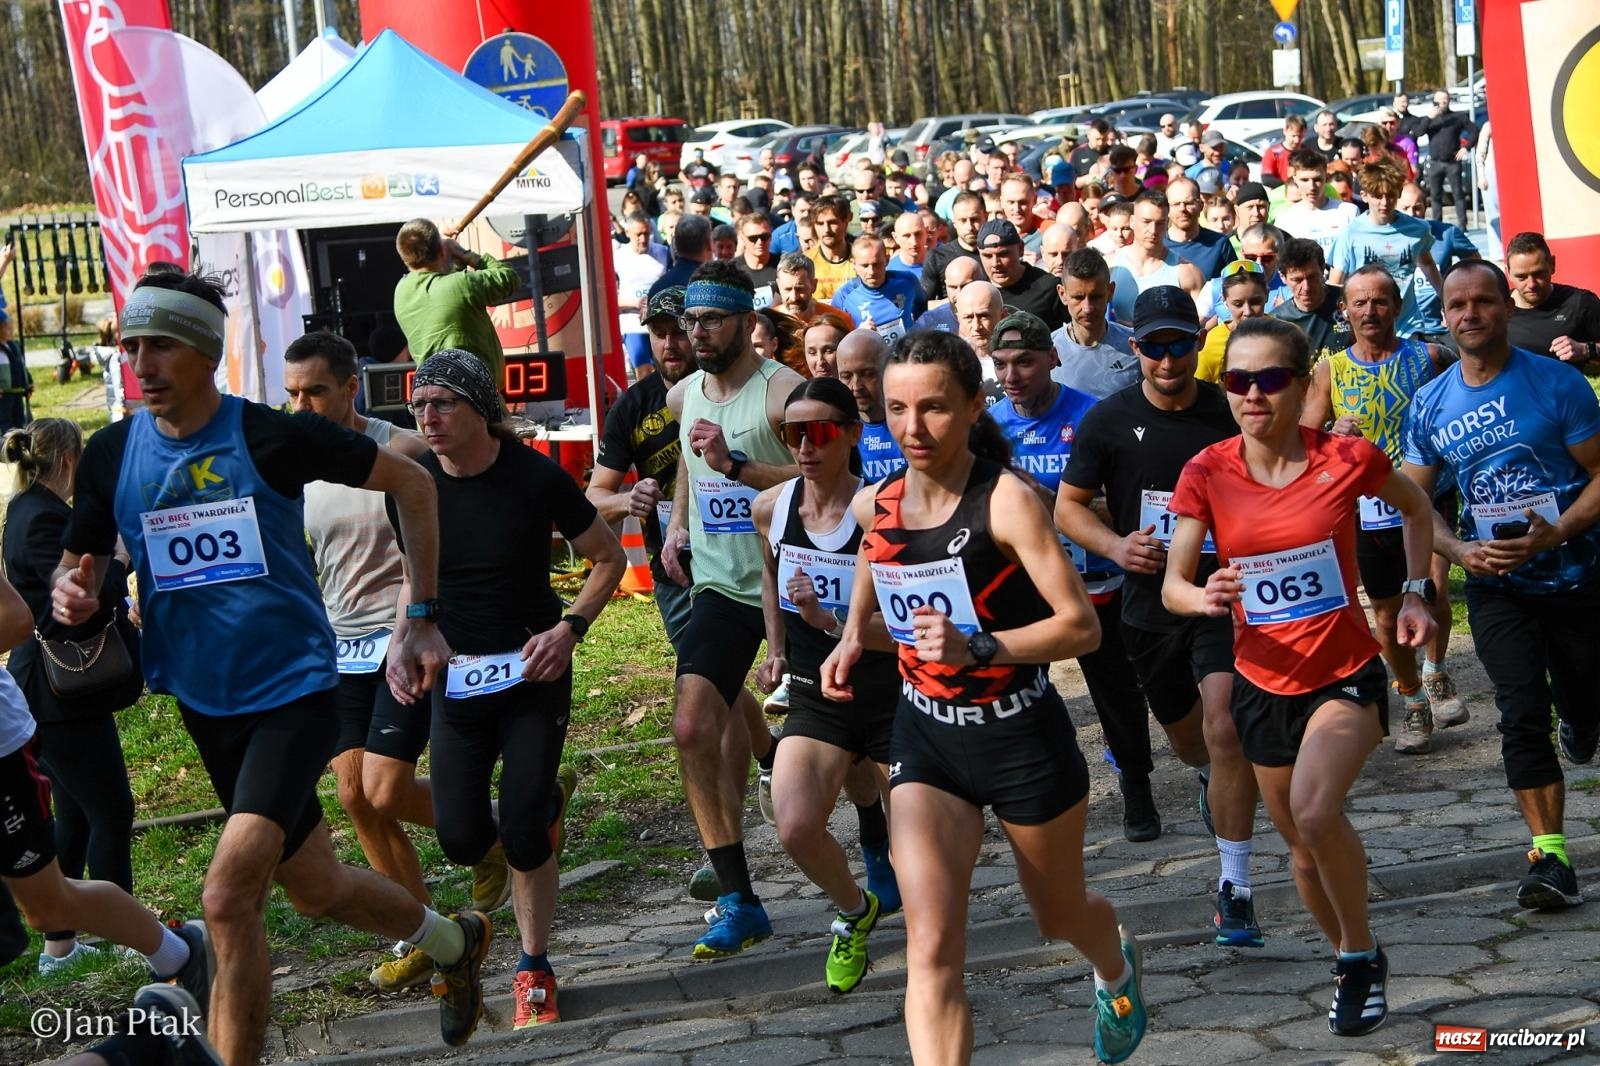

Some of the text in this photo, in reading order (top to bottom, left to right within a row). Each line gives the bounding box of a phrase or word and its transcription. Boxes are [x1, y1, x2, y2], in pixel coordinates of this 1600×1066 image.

[516, 177, 551, 188] MITKO
[215, 183, 353, 208] PersonalBest
[505, 362, 548, 394] 03
[1431, 396, 1507, 452] MORSY
[150, 517, 165, 527] XIV
[168, 513, 189, 523] BIEG
[709, 497, 752, 519] 023
[168, 530, 242, 566] 003
[797, 553, 812, 562] BIEG
[1253, 560, 1273, 569] BIEG
[810, 573, 841, 601] 31
[1256, 571, 1323, 605] 063
[465, 662, 510, 687] 021
